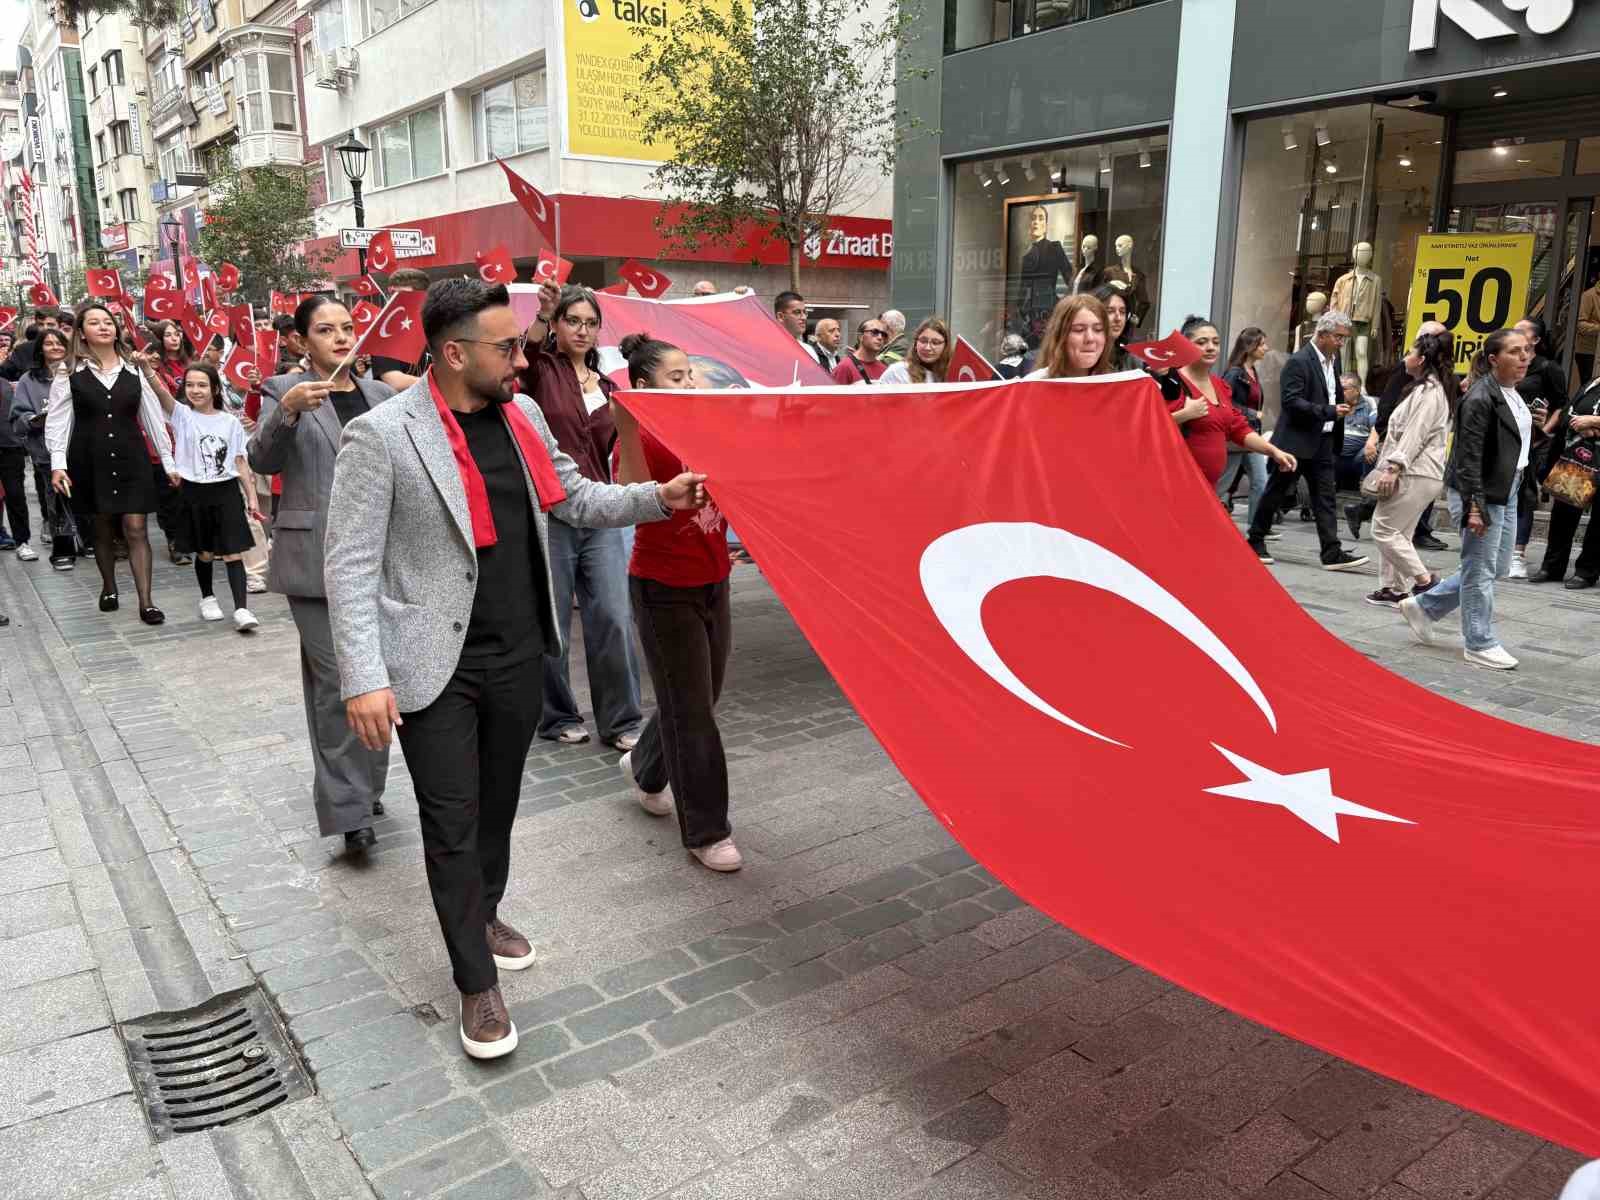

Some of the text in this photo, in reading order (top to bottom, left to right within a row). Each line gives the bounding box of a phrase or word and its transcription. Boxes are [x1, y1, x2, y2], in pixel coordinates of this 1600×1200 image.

[612, 0, 666, 27] taksi
[826, 229, 879, 257] Ziraat
[1422, 267, 1513, 334] 50
